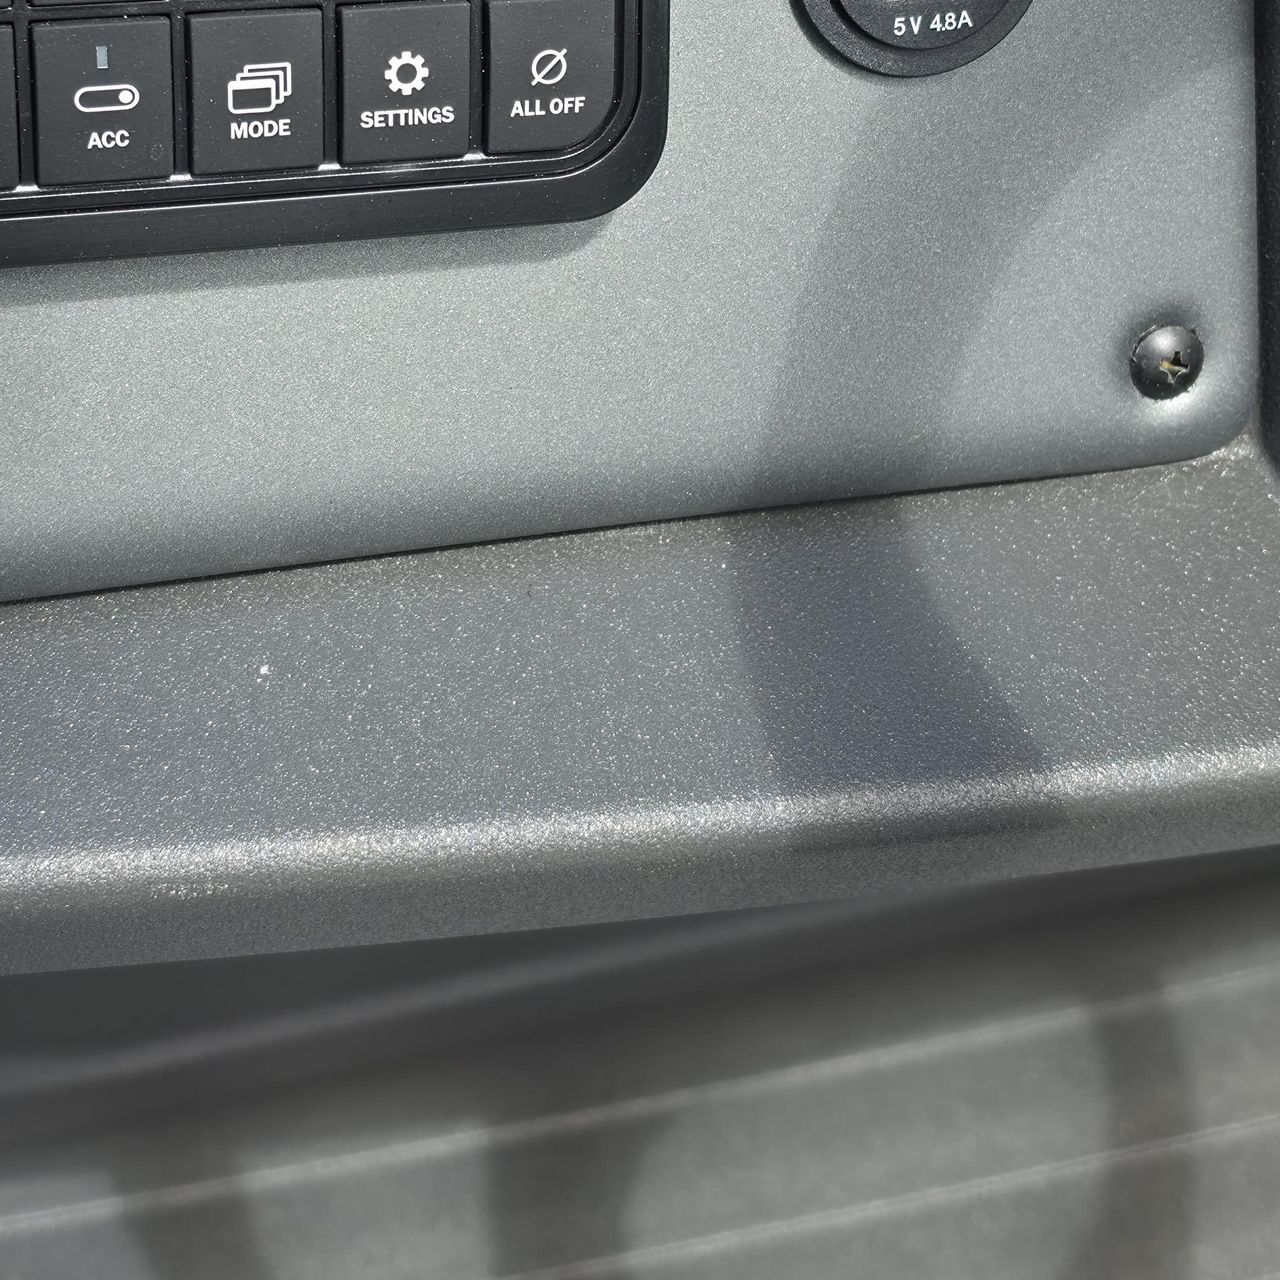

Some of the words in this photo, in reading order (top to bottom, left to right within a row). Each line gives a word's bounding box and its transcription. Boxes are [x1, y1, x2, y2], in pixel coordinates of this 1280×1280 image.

[929, 9, 974, 32] 4.8A
[359, 105, 455, 129] SETTINGS
[509, 98, 547, 118] ALL
[549, 95, 587, 115] OFF
[86, 129, 130, 150] ACC
[230, 118, 292, 140] MODE
